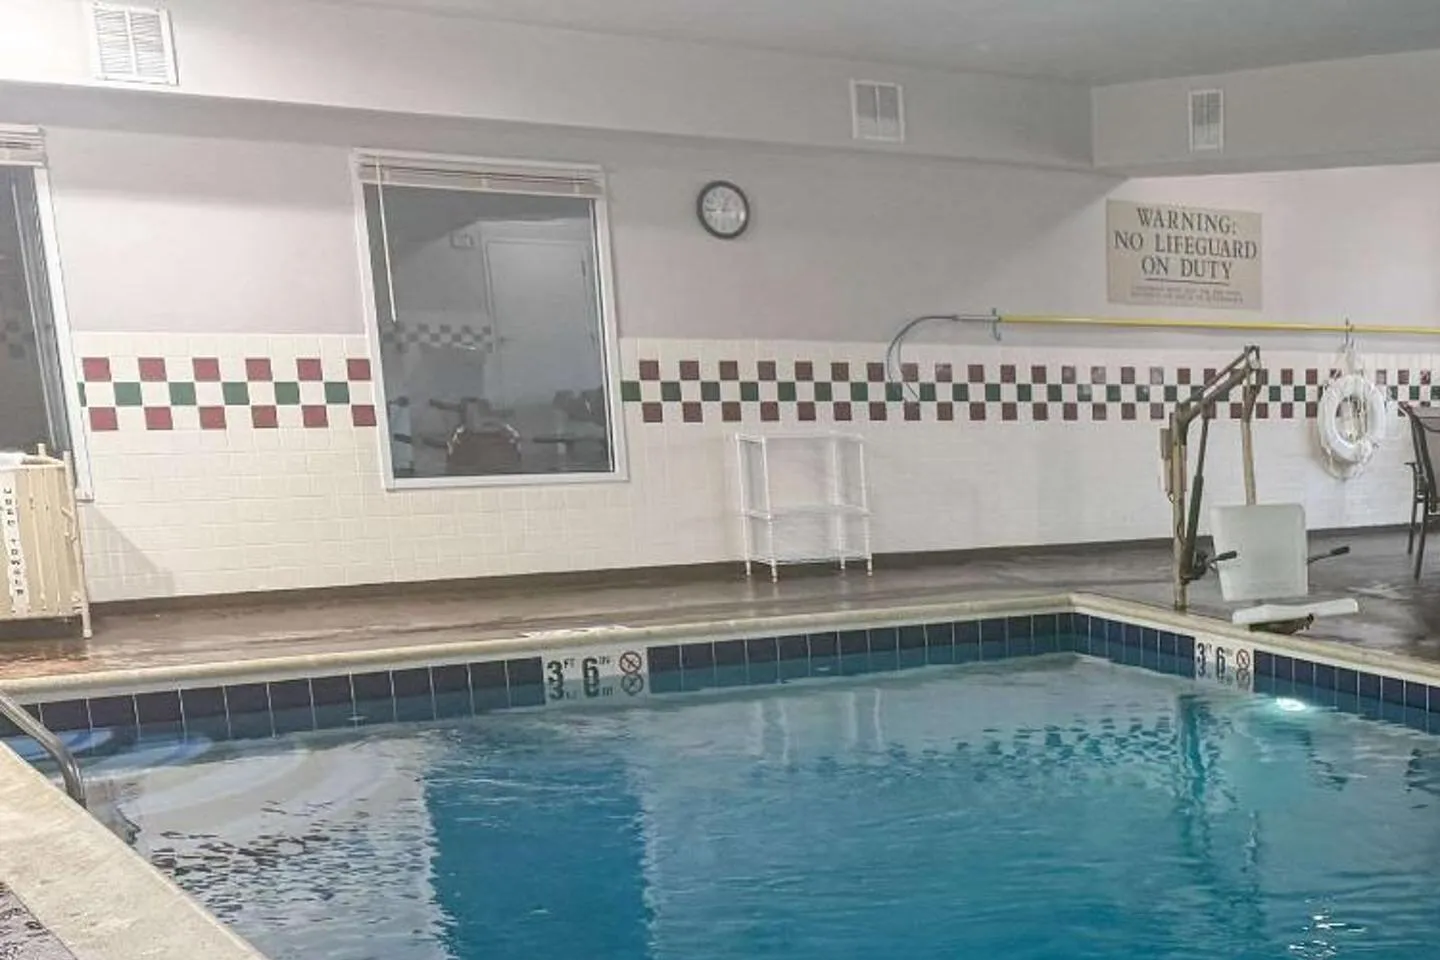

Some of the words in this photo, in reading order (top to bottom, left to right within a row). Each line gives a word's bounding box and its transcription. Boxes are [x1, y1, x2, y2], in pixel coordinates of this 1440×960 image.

[1114, 230, 1144, 252] NO
[1155, 233, 1257, 260] LIFEGUARD
[1141, 256, 1169, 276] ON
[1180, 258, 1233, 280] DUTY
